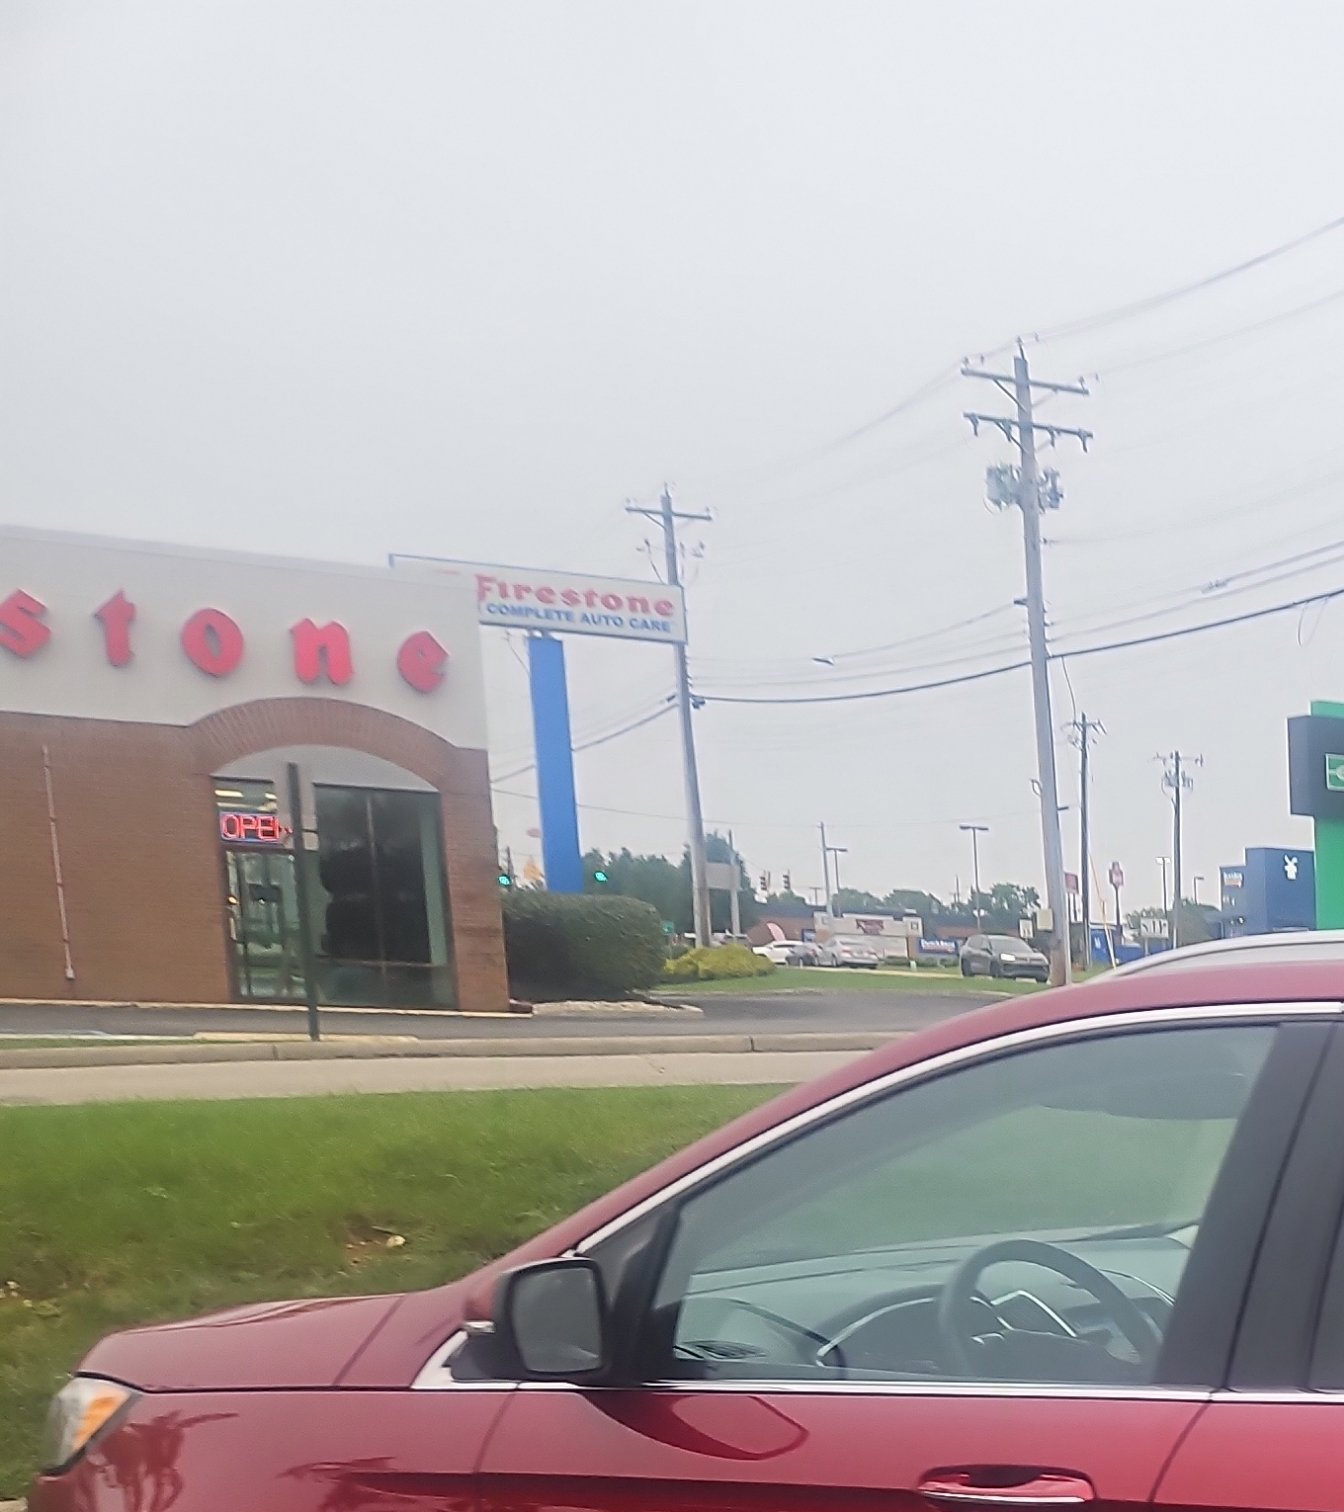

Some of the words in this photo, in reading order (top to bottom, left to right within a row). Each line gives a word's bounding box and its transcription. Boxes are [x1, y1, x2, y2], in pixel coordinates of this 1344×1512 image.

[475, 574, 675, 618] Firestone
[486, 602, 575, 623] COMPLETE
[580, 611, 624, 628] AUTO
[628, 617, 671, 633] CARE
